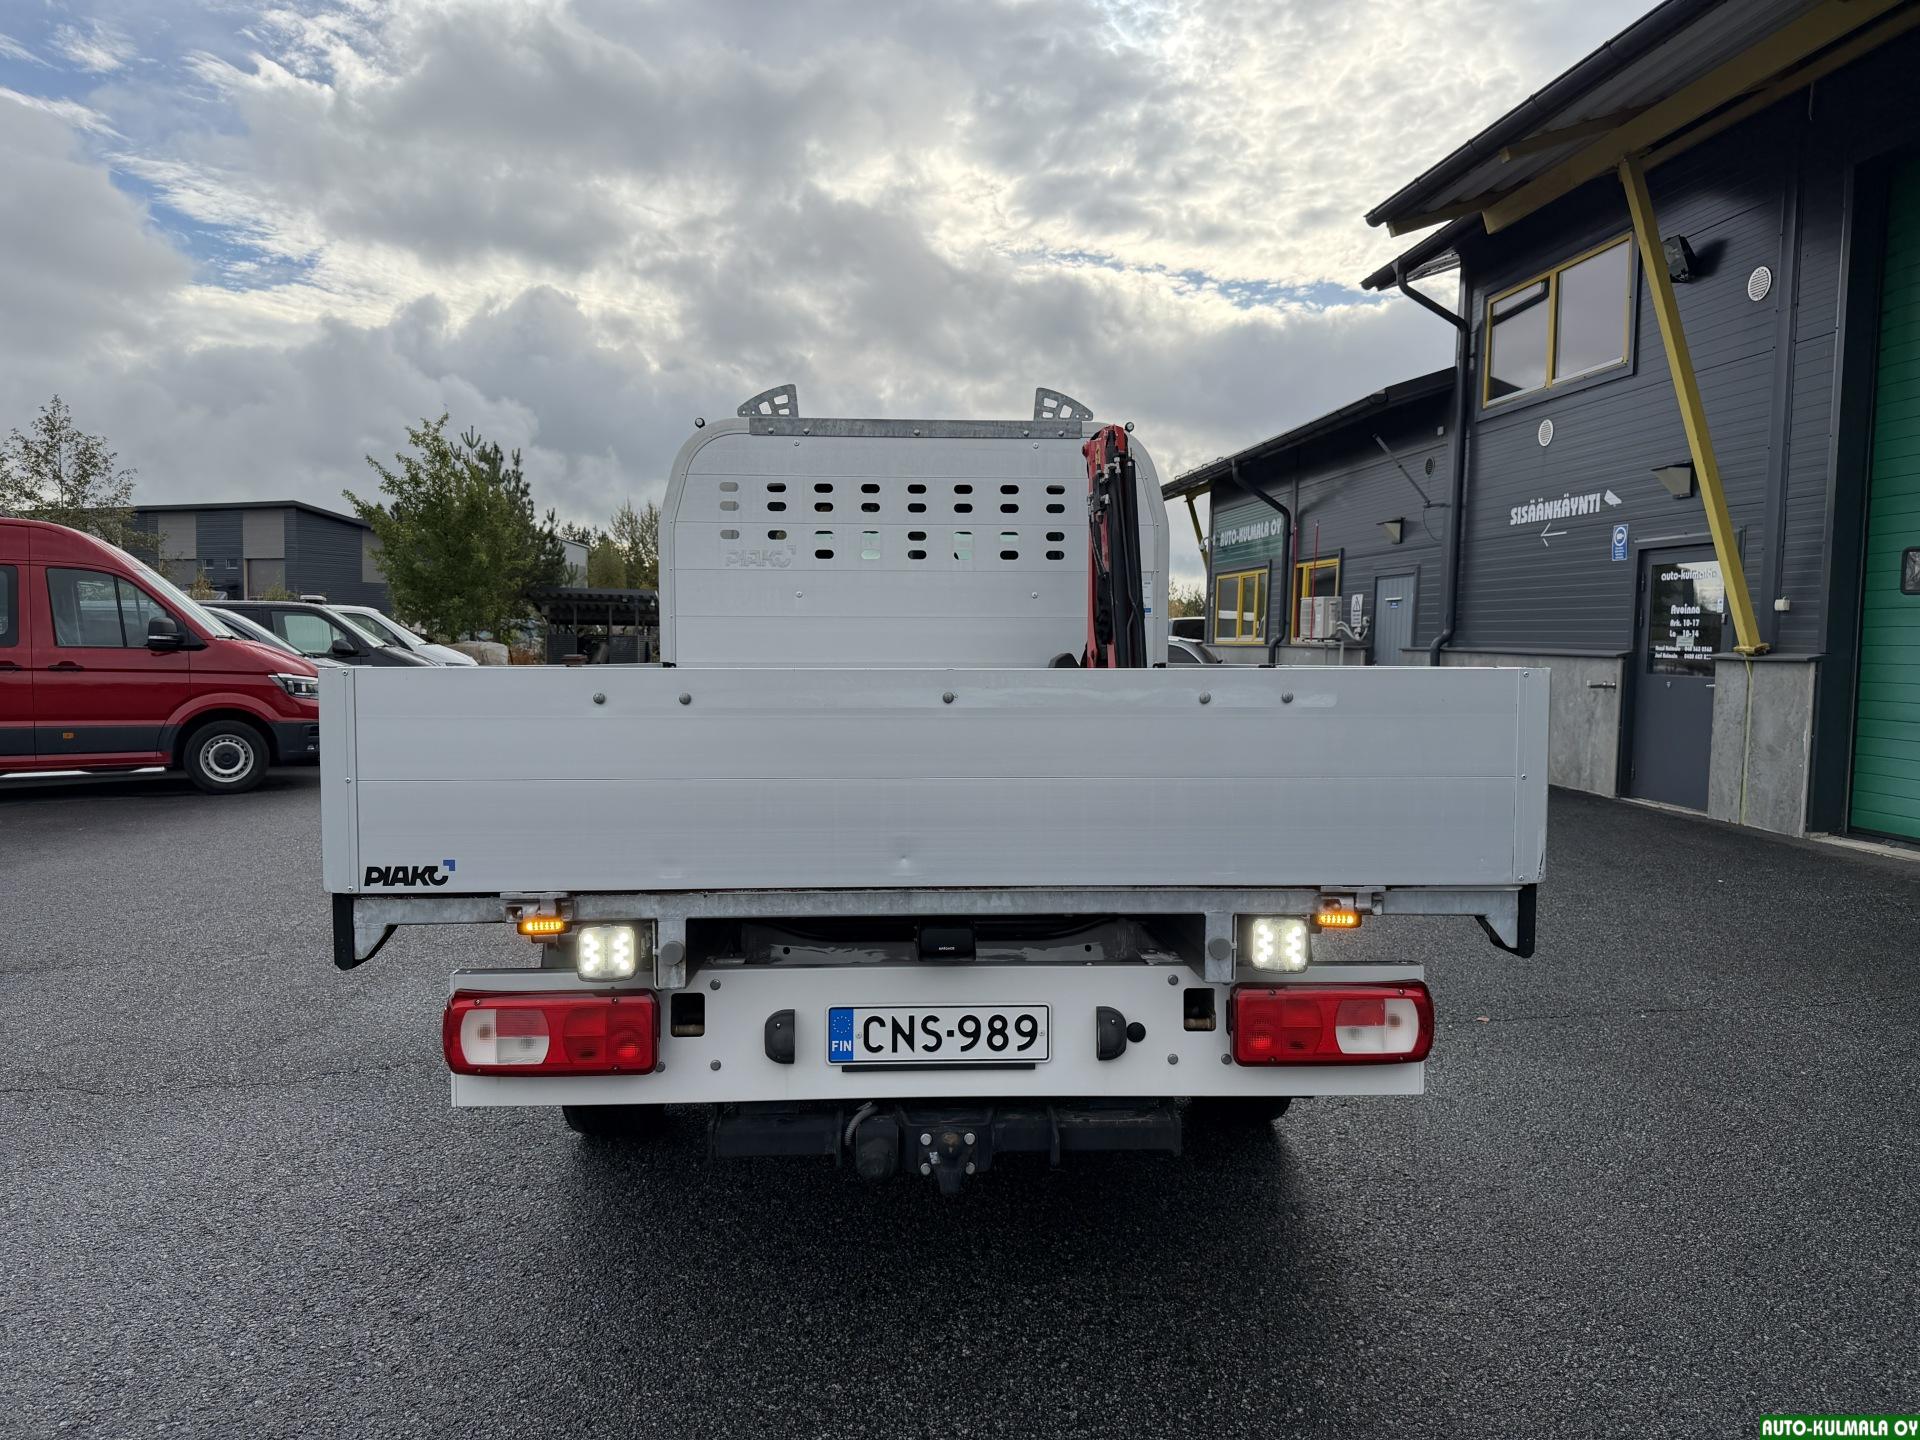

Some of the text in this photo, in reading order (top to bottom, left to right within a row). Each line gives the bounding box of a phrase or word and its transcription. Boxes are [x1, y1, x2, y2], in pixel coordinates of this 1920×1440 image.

[1510, 493, 1601, 526] SISÄÄNKÄYNTI
[1220, 518, 1282, 547] AUTO-KULMALA OY
[1670, 603, 1701, 615] Avoinna
[1683, 619, 1700, 627] 10-17
[863, 1014, 1039, 1053] CNS-989
[831, 1040, 852, 1052] FIN
